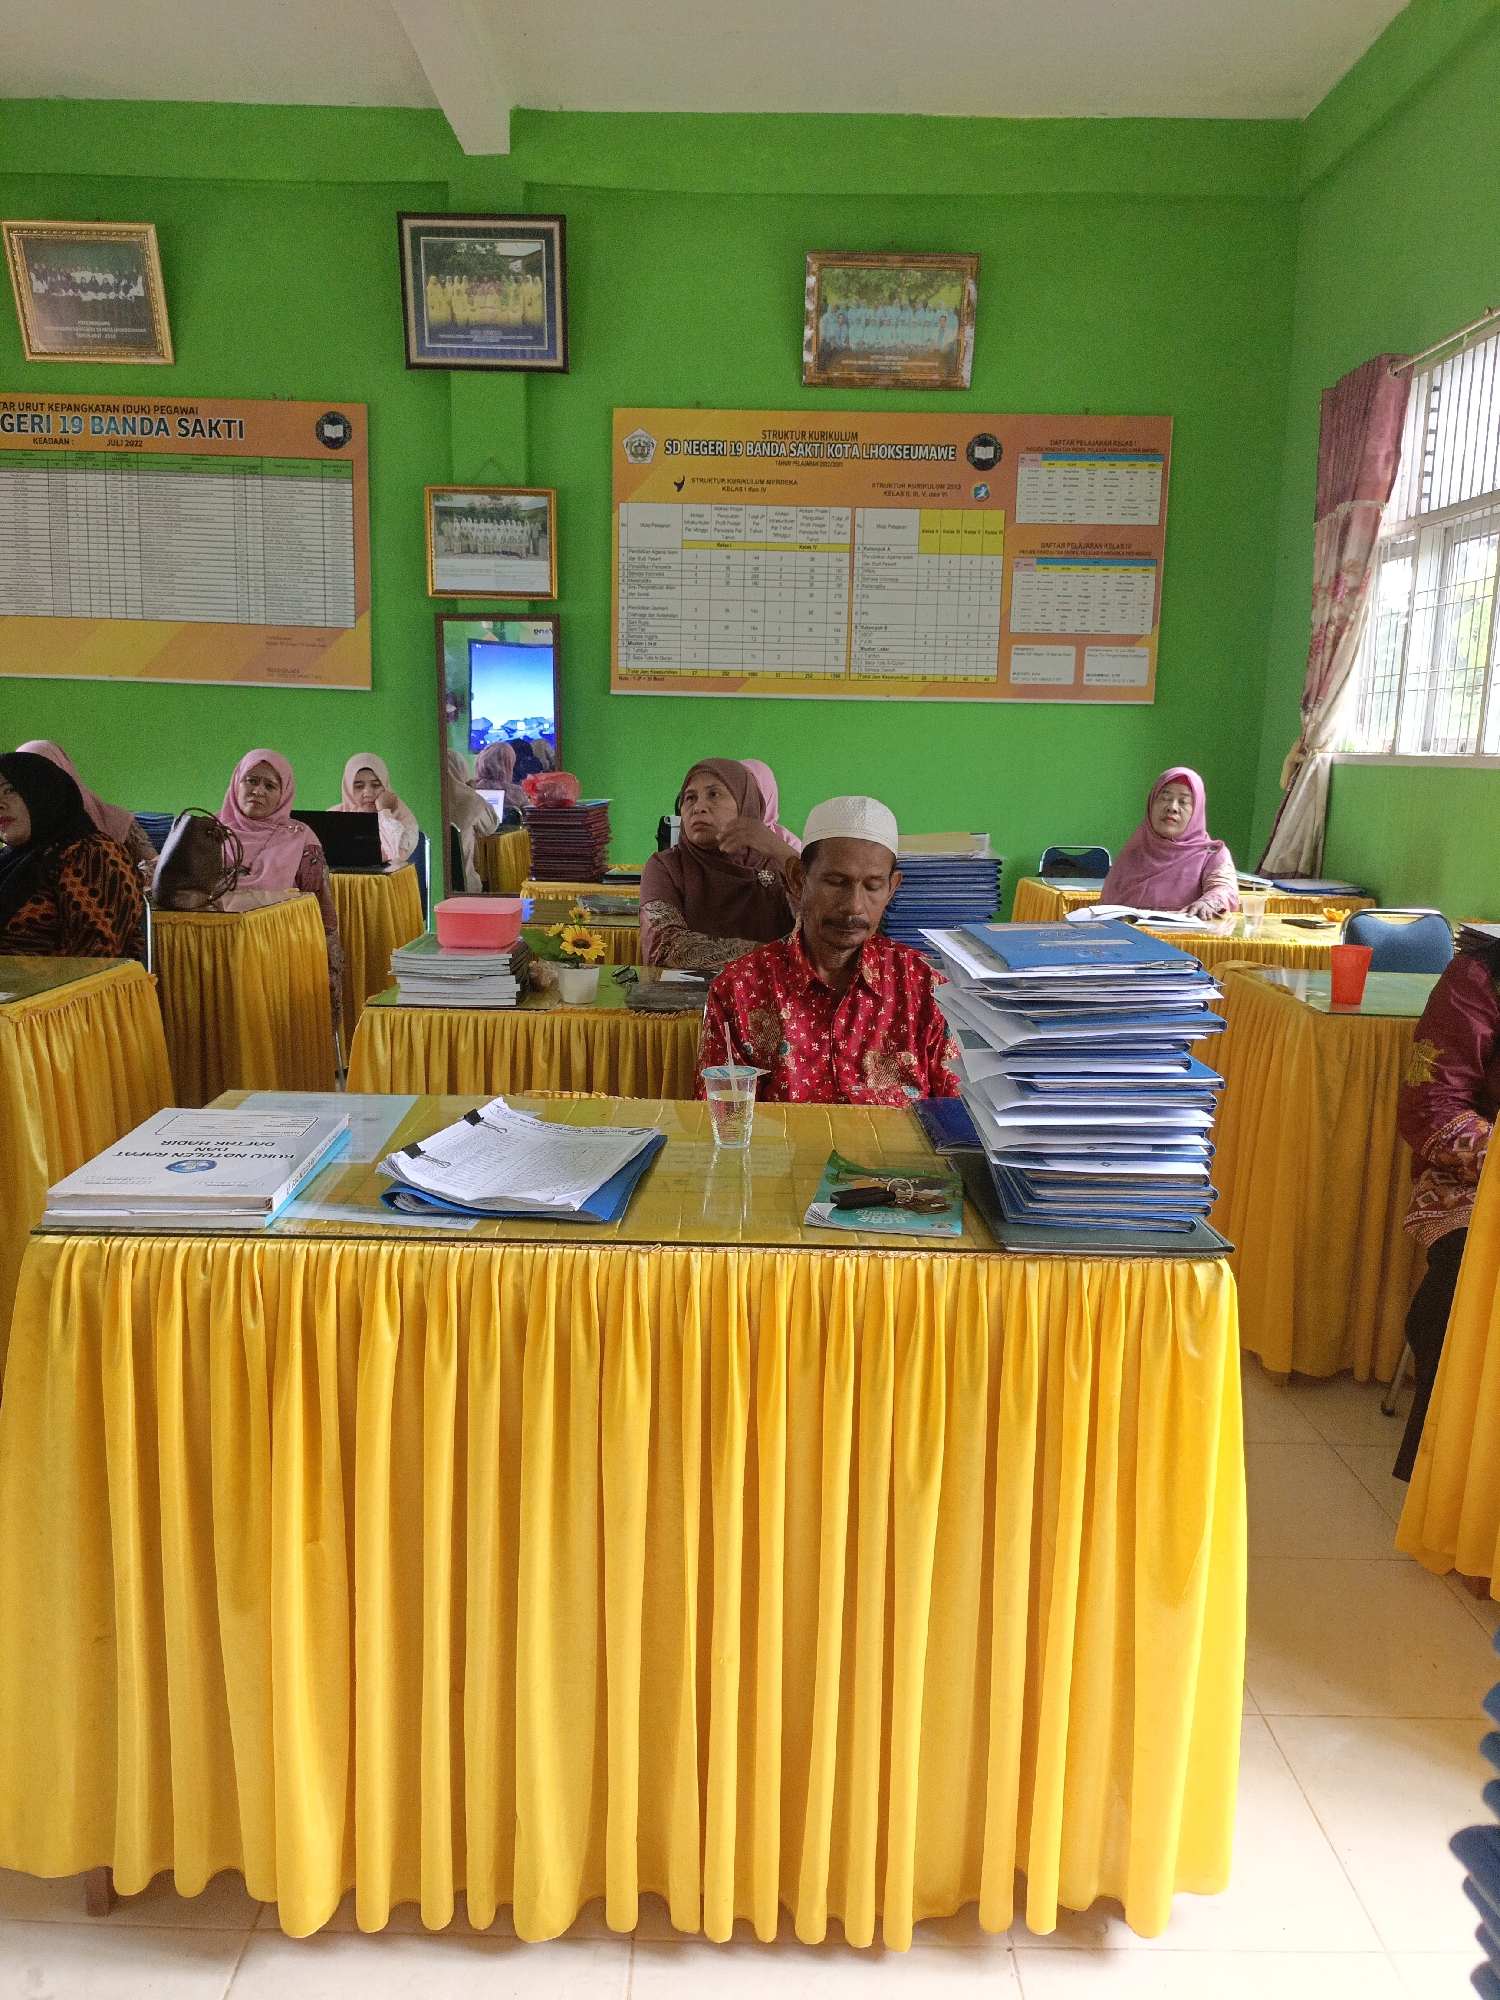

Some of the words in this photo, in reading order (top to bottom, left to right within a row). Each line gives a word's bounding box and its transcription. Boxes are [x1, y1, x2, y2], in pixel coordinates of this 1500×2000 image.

[18, 402, 45, 412] URUT
[47, 402, 120, 413] KEPANGKATAN
[122, 404, 151, 415] (DUK)
[153, 404, 199, 415] PEGAWAI
[58, 414, 84, 435] 19
[89, 414, 172, 438] BANDA
[176, 416, 245, 440] SAKTI
[761, 429, 806, 441] STRUKTUR
[808, 430, 859, 442] KURIKULUM
[32, 437, 70, 445] KEADAAN
[107, 439, 123, 447] JULI
[125, 440, 143, 448] 2022
[664, 438, 681, 456] SD
[683, 439, 727, 456] NEGERI
[730, 440, 744, 456] 19
[746, 441, 788, 458] BANDA
[788, 442, 824, 458] SAKTI
[827, 442, 861, 459] KOTA
[862, 443, 957, 461] LHOKSEUMAWE
[883, 490, 905, 498] KELAS
[1066, 542, 1103, 550] PELAJARAN
[171, 1151, 248, 1159] NOTULEN
